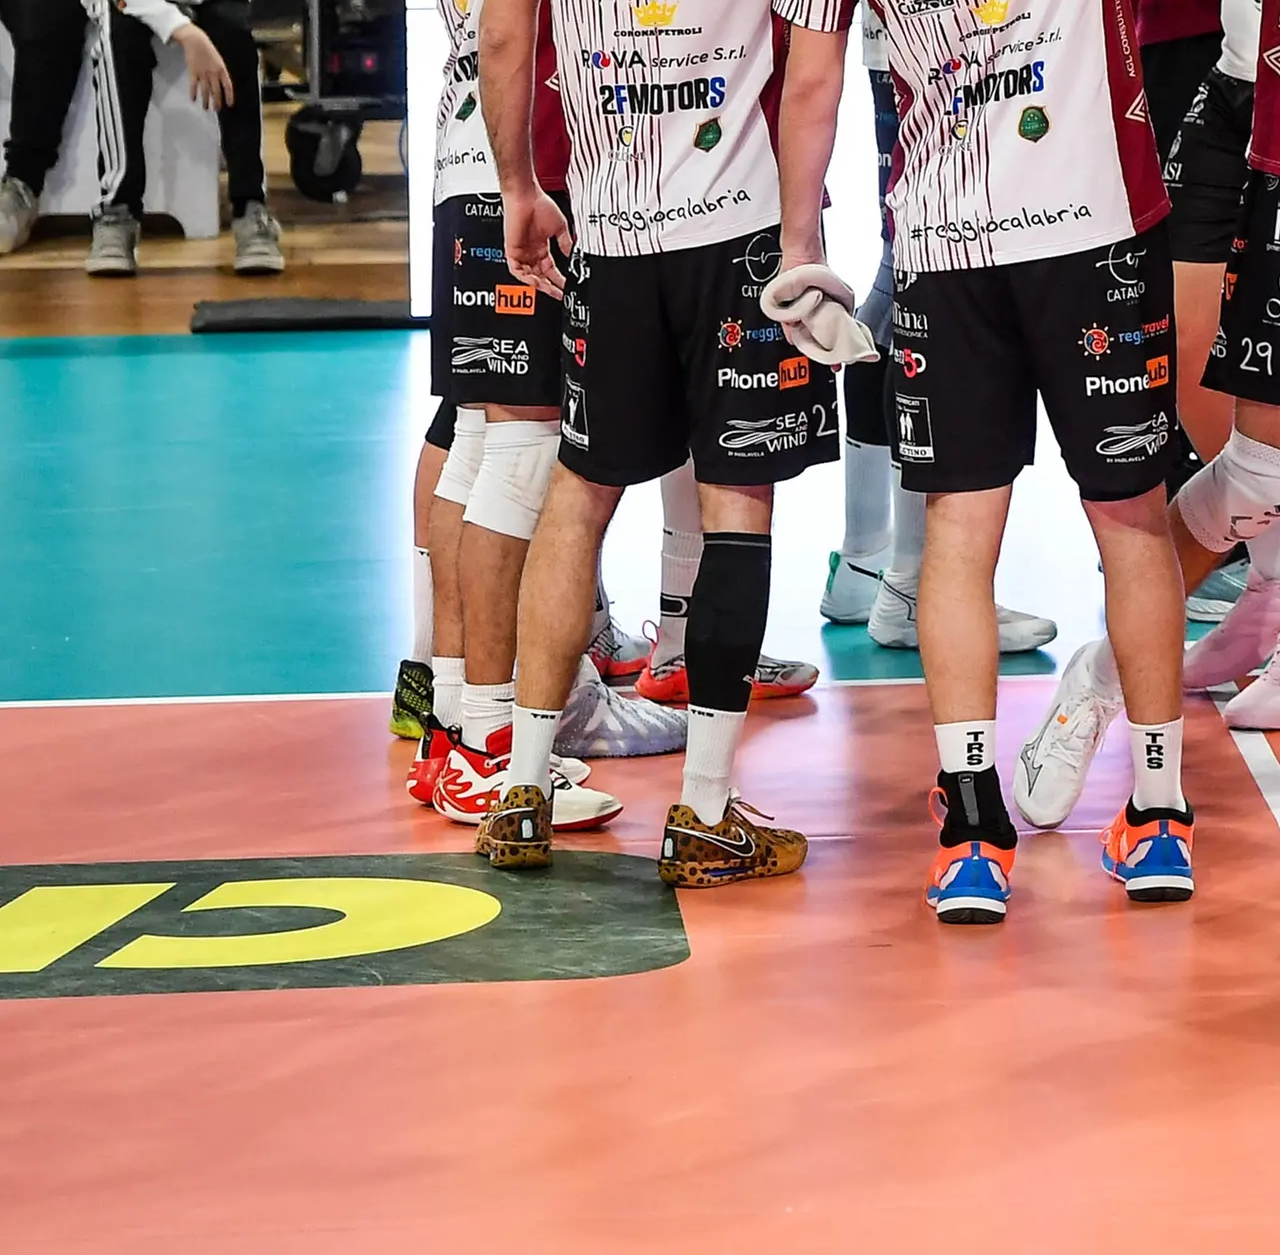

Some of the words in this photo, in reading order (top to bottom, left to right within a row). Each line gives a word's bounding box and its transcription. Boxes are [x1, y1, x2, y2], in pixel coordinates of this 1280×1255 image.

[651, 54, 708, 68] service
[713, 46, 746, 61] S.r.l.
[600, 76, 725, 115] 2FMOTORS
[588, 188, 751, 232] #reggiocalabria
[910, 202, 1091, 242] #reggiocalabria
[493, 339, 529, 354] SEA
[1240, 337, 1273, 376] 29
[488, 358, 529, 375] WIND
[776, 412, 808, 428] SEA
[766, 432, 808, 452] WIND
[966, 730, 985, 766] TRS
[1145, 732, 1164, 770] TRS
